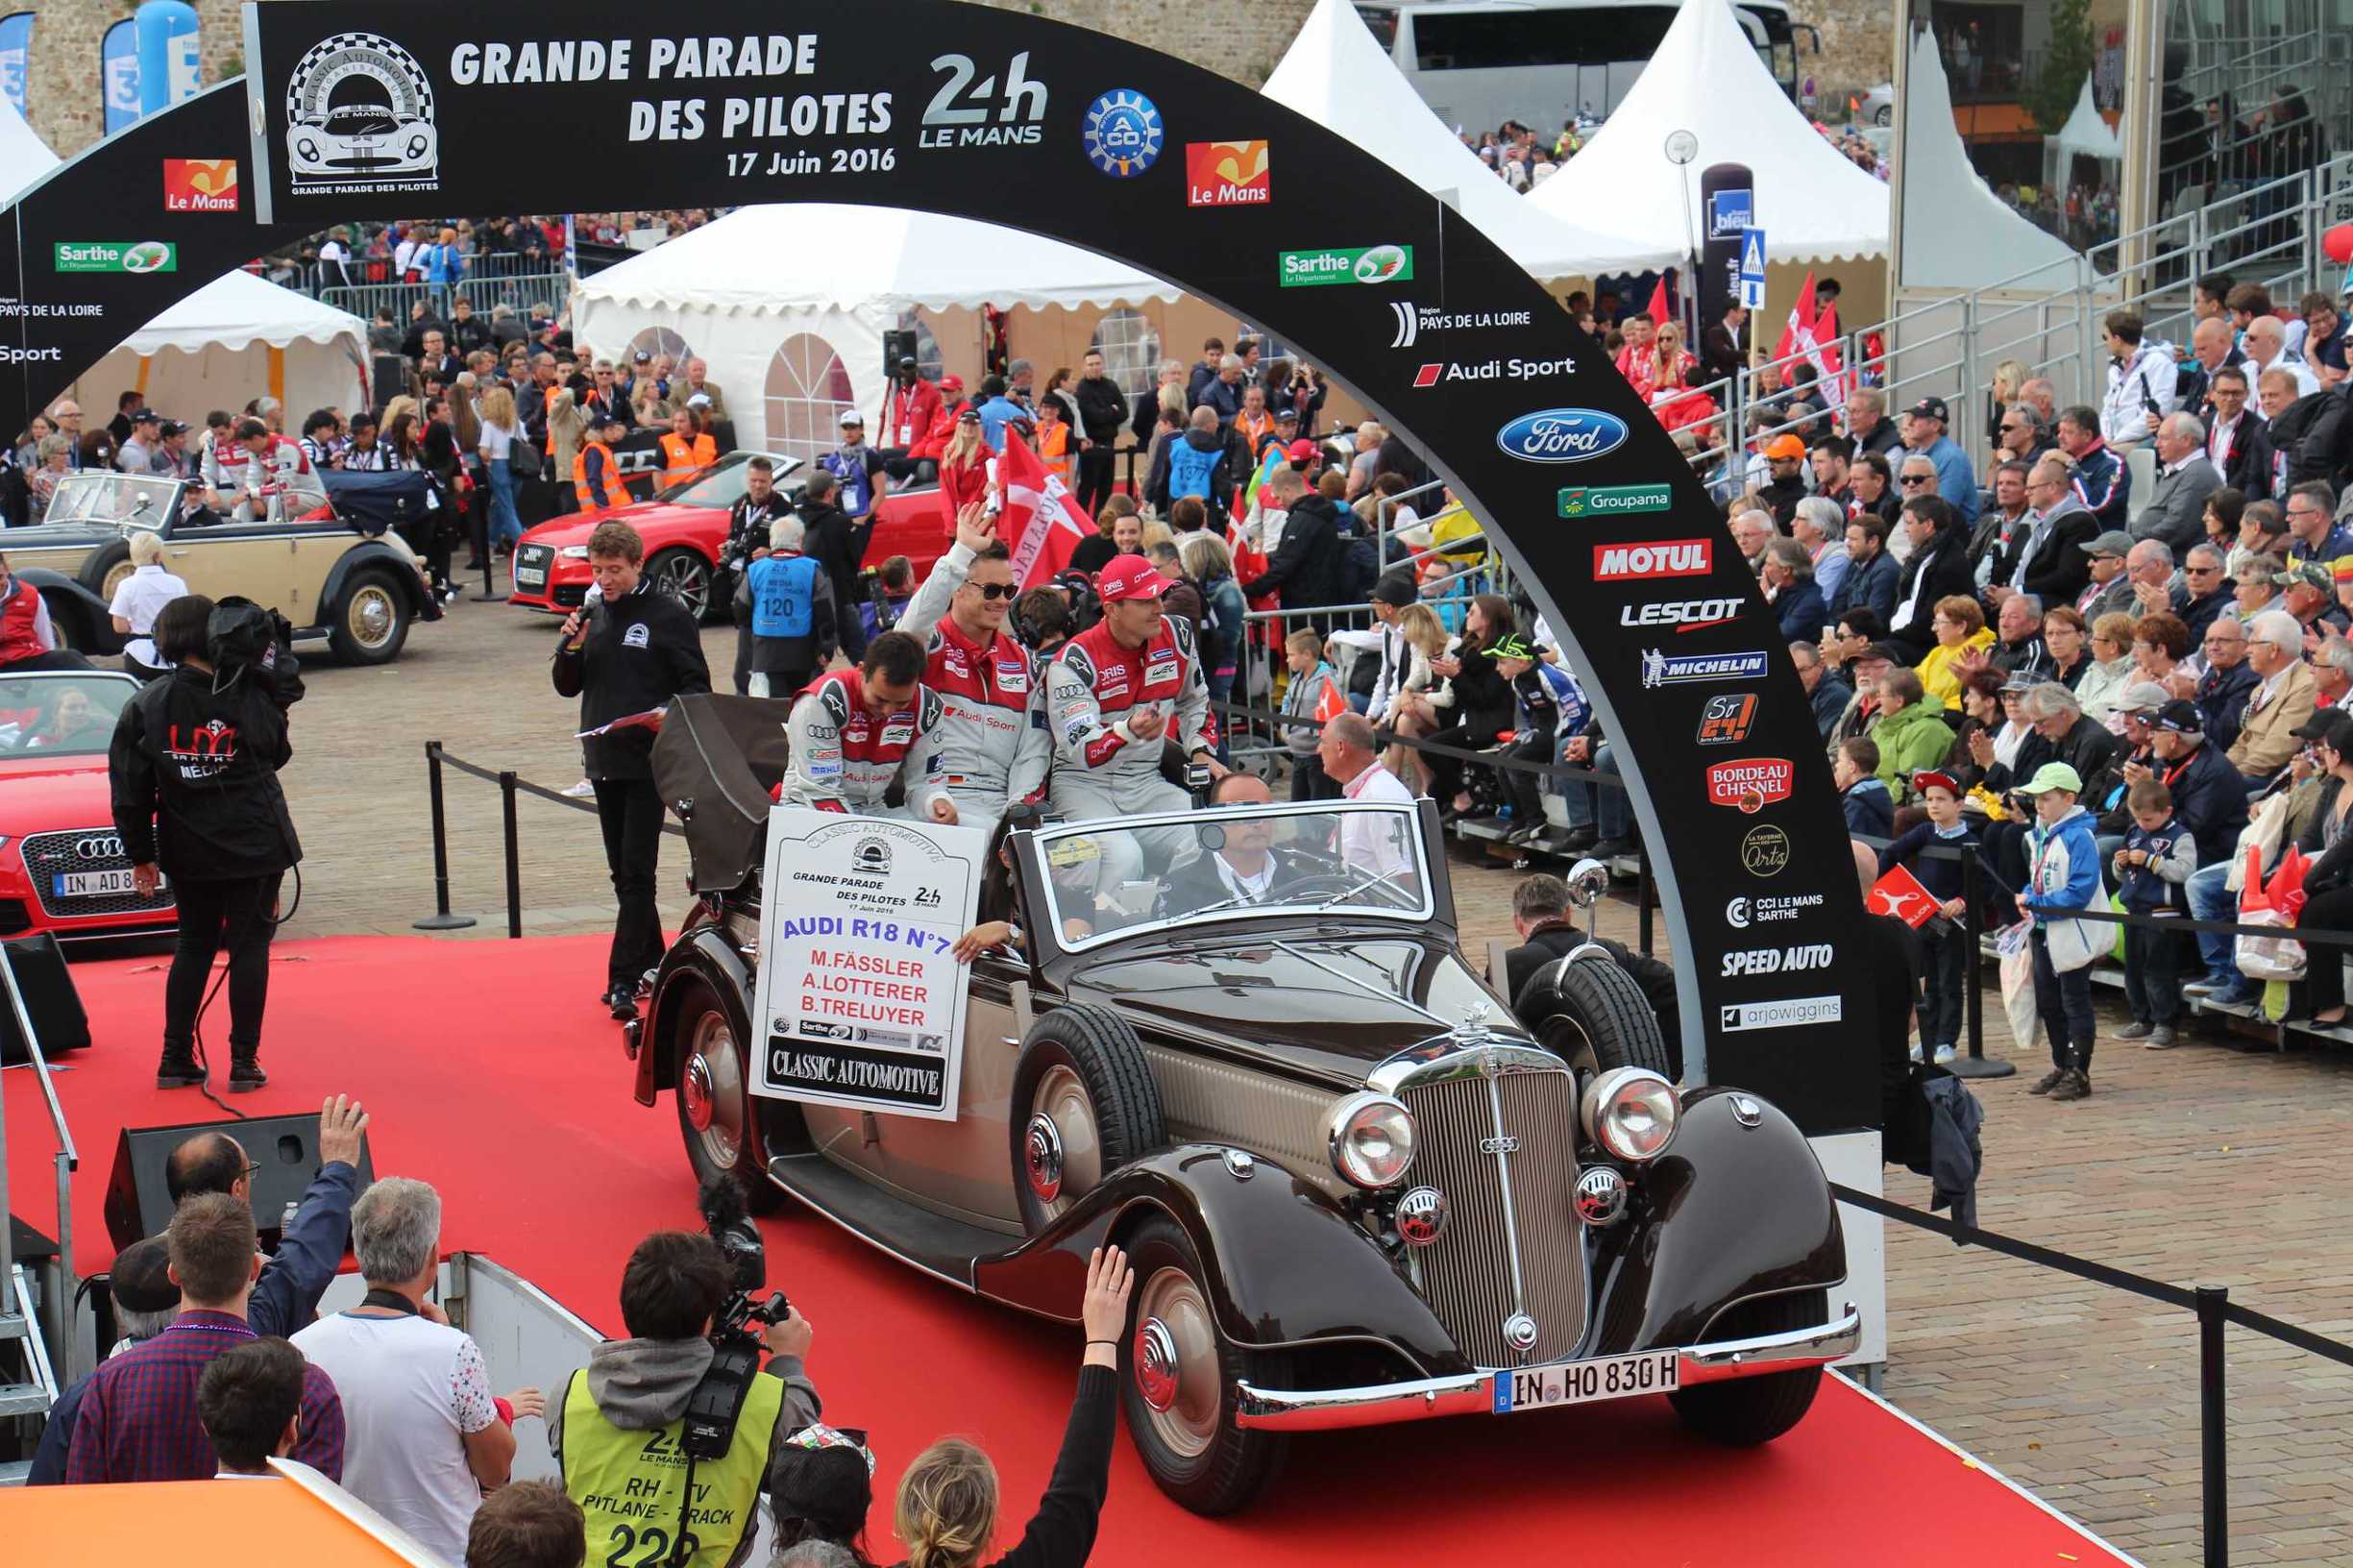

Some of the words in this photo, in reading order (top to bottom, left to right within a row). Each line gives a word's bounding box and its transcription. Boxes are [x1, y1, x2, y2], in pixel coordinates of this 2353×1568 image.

[450, 39, 631, 86] GRANDE
[649, 34, 819, 80] PARADE
[342, 50, 415, 110] AUTOMOTIVE
[922, 50, 1048, 126] 24h
[628, 99, 707, 142] DES
[723, 91, 893, 138] PILOTES
[919, 128, 954, 148] LE
[959, 125, 1042, 147] MANS
[727, 152, 757, 177] 17
[766, 149, 821, 176] Juin
[830, 148, 896, 174] 2016
[291, 186, 332, 195] GRANDE
[335, 184, 374, 193] PARADE
[376, 184, 395, 192] DES
[398, 182, 439, 191] PILOTES
[1191, 184, 1213, 204] Le
[1218, 183, 1267, 202] Mans
[168, 194, 187, 208] Le
[191, 195, 235, 209] Mans
[1717, 212, 1752, 231] bleu
[60, 246, 119, 261] Sarthe
[1285, 254, 1350, 274] Sarthe
[32, 305, 48, 317] DE
[51, 305, 66, 317] LA
[69, 305, 104, 317] LOIRE
[1419, 306, 1441, 316] Région
[1419, 315, 1453, 331] PAYS
[1456, 314, 1473, 329] DE
[1476, 313, 1492, 327] LA
[1494, 310, 1532, 327] LOIRE
[1445, 359, 1501, 381] Audi
[1507, 356, 1576, 380] Sport
[1522, 417, 1602, 454] Ford
[1590, 493, 1669, 509] Groupama
[1599, 544, 1707, 576] MOTUL
[1103, 578, 1124, 593] ORIS
[1147, 584, 1159, 596] 7
[762, 598, 795, 618] 120
[1620, 598, 1746, 627] LESCOT
[1667, 657, 1763, 676] MICHELIN
[957, 709, 982, 723] Audi
[986, 717, 1017, 732] Sport
[1712, 765, 1788, 783] BORDEAU
[1715, 780, 1785, 797] CHESNEL
[806, 822, 862, 850] CLASSIC
[864, 823, 945, 864] AUTOMOTIVE
[792, 870, 839, 886] GRANDE
[839, 876, 885, 891] PARADE
[836, 890, 858, 901] DES
[861, 893, 908, 907] PILOTES
[1756, 898, 1777, 911] CCI
[1778, 897, 1791, 909] LE
[1792, 894, 1825, 908] MANS
[859, 904, 875, 913] Juin
[876, 906, 895, 915] 2016
[1756, 908, 1799, 922] SARTHE
[783, 917, 844, 940] AUDI
[852, 919, 898, 943] R18
[906, 927, 952, 956] N°7
[811, 949, 923, 979] M.FÄSSLER
[1721, 948, 1781, 977] SPEED
[1781, 943, 1834, 972] AUTO
[802, 972, 928, 1004] A.LOTTERER
[801, 995, 925, 1027] B.TRELUYER
[1747, 1002, 1839, 1024] arjowiggins
[801, 1021, 829, 1034] Sarthe
[772, 1048, 837, 1082] CLASSIC
[837, 1058, 940, 1097] AUTOMOTIVE
[1512, 1372, 1543, 1406] IN
[1565, 1365, 1599, 1399] HO
[1660, 1355, 1677, 1386] H
[639, 1454, 654, 1462] LE
[655, 1455, 690, 1466] MANS
[625, 1477, 662, 1498] RH
[583, 1494, 659, 1519] PITLANE
